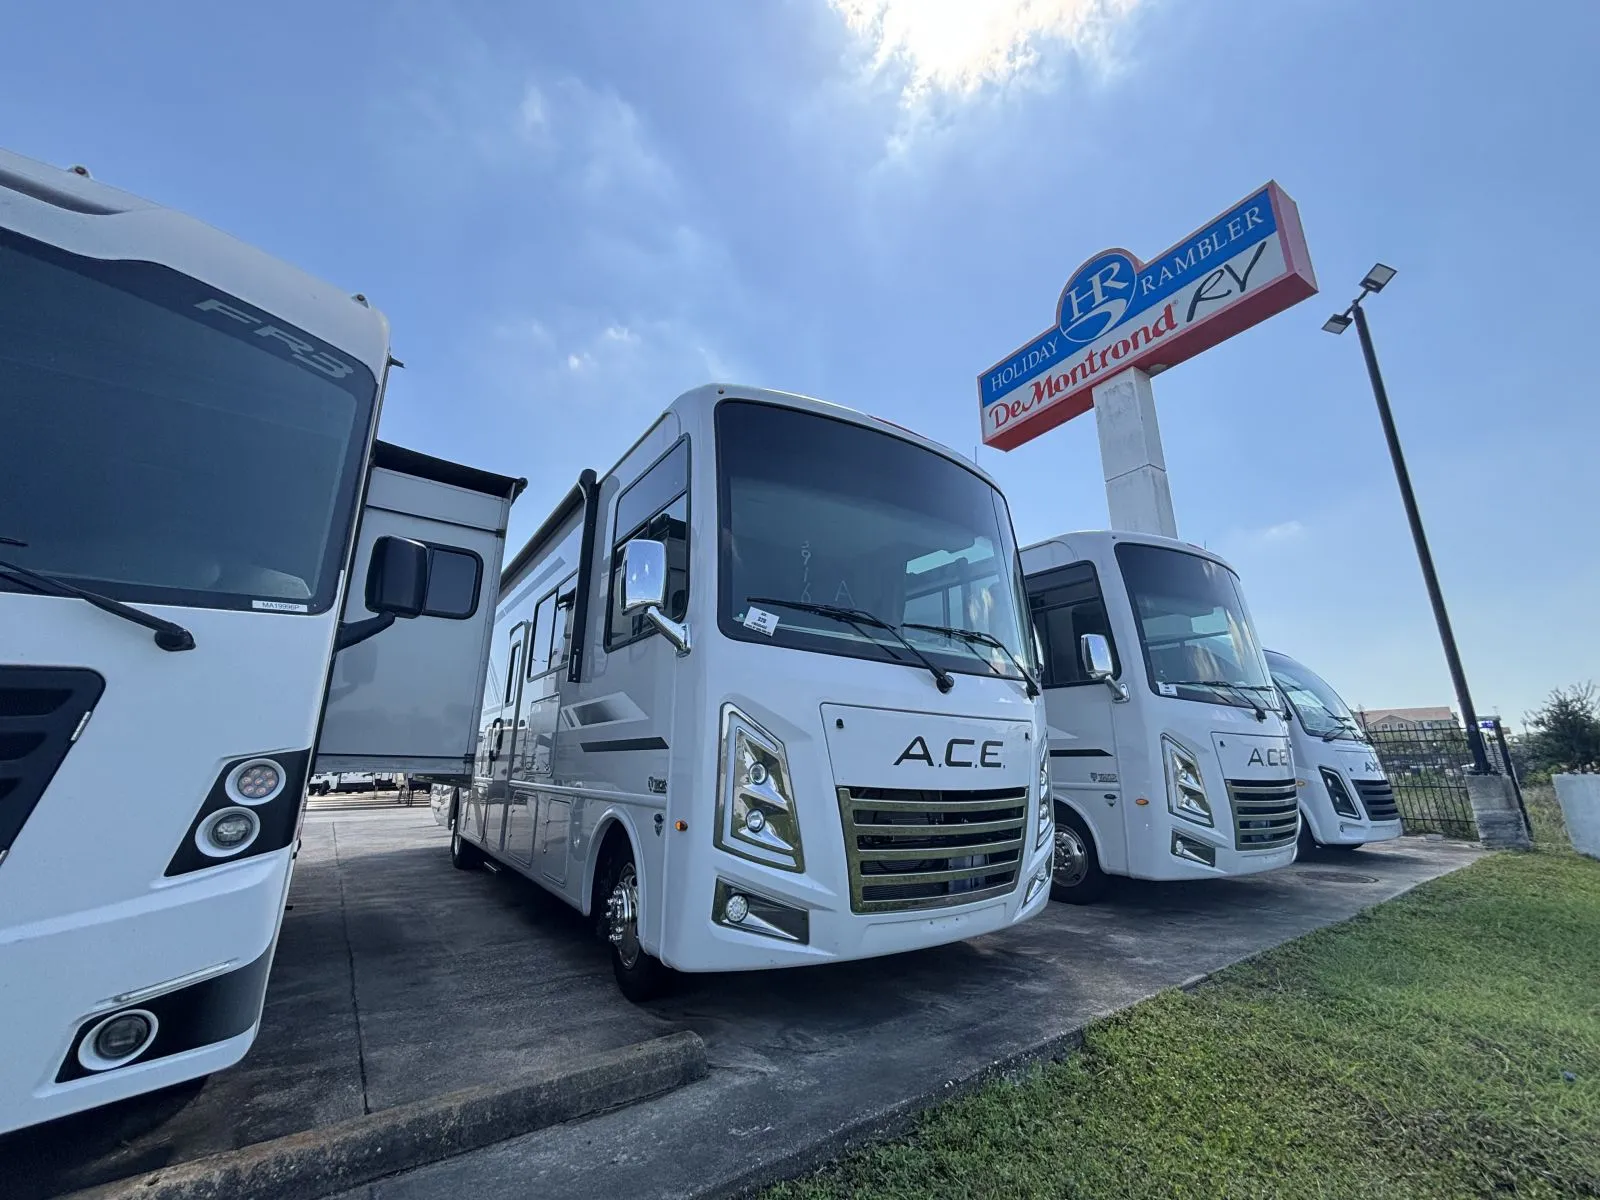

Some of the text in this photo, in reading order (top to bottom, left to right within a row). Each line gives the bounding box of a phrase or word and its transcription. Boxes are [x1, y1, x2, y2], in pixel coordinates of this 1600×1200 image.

[1140, 206, 1264, 296] RAMBLER
[193, 298, 354, 379] FR3
[988, 241, 1267, 429] DeMontrond RV
[991, 337, 1058, 392] HOLIDAY
